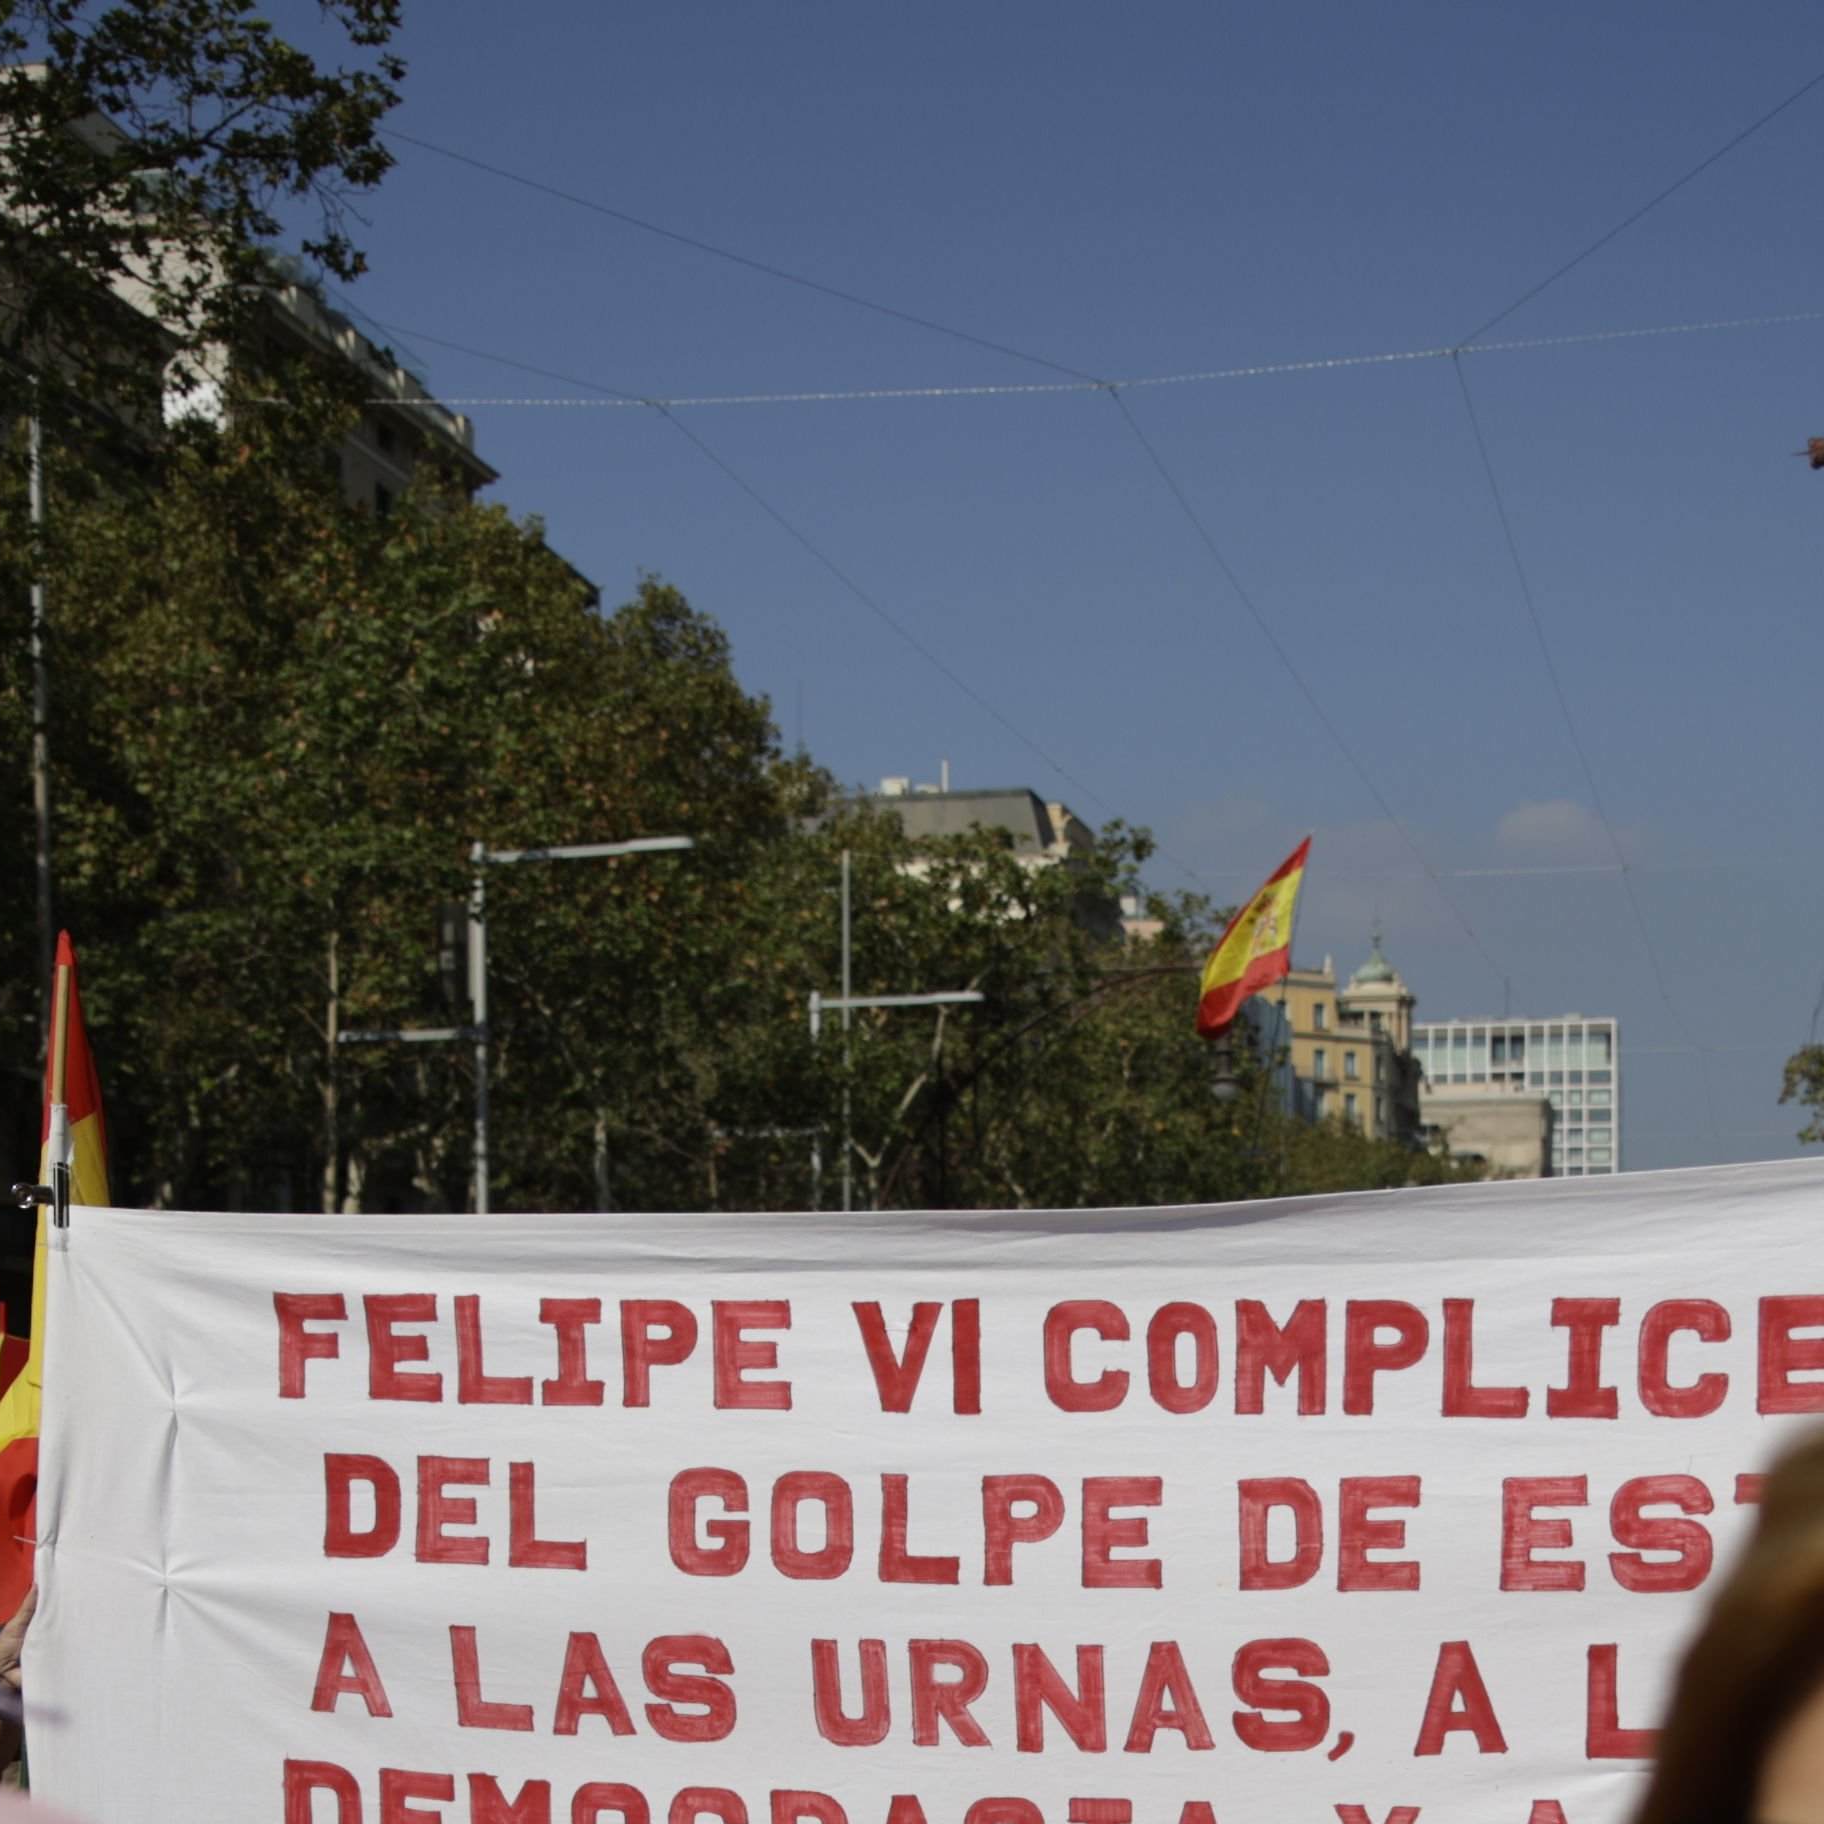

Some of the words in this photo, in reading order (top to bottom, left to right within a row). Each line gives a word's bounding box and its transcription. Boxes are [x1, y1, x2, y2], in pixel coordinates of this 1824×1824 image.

[277, 1293, 790, 1408] FELIPE
[855, 1300, 981, 1414] VI
[325, 1454, 587, 1569] DEL
[670, 1468, 1163, 1588] GOLPE
[1239, 1476, 1421, 1591] DE
[314, 1614, 390, 1716] A
[452, 1626, 736, 1742] LAS
[813, 1638, 1354, 1762] URNAS,
[1415, 1641, 1507, 1756] A
[1587, 1643, 1666, 1759] L
